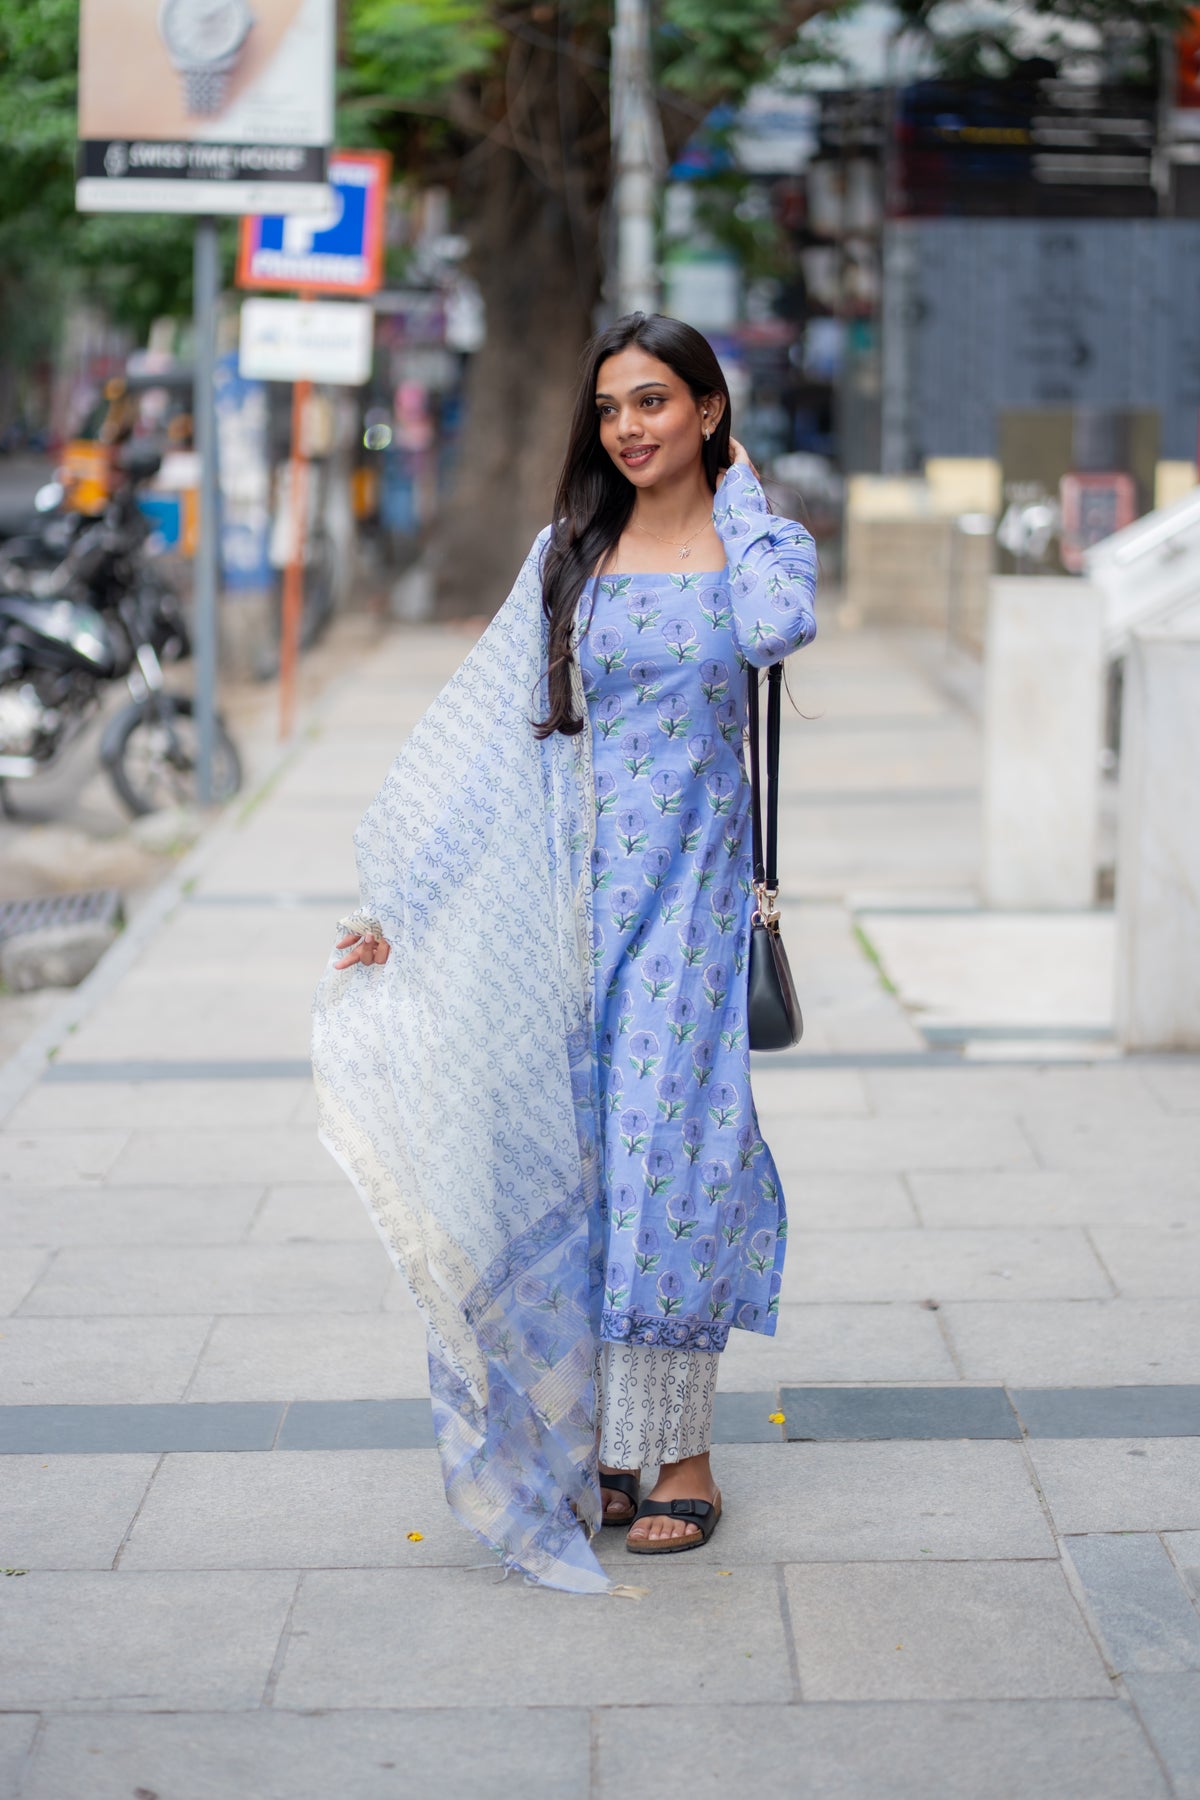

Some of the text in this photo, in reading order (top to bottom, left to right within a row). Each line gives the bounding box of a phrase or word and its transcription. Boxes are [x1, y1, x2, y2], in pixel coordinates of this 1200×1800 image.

[130, 144, 304, 171] SWISS TIME HOUSE
